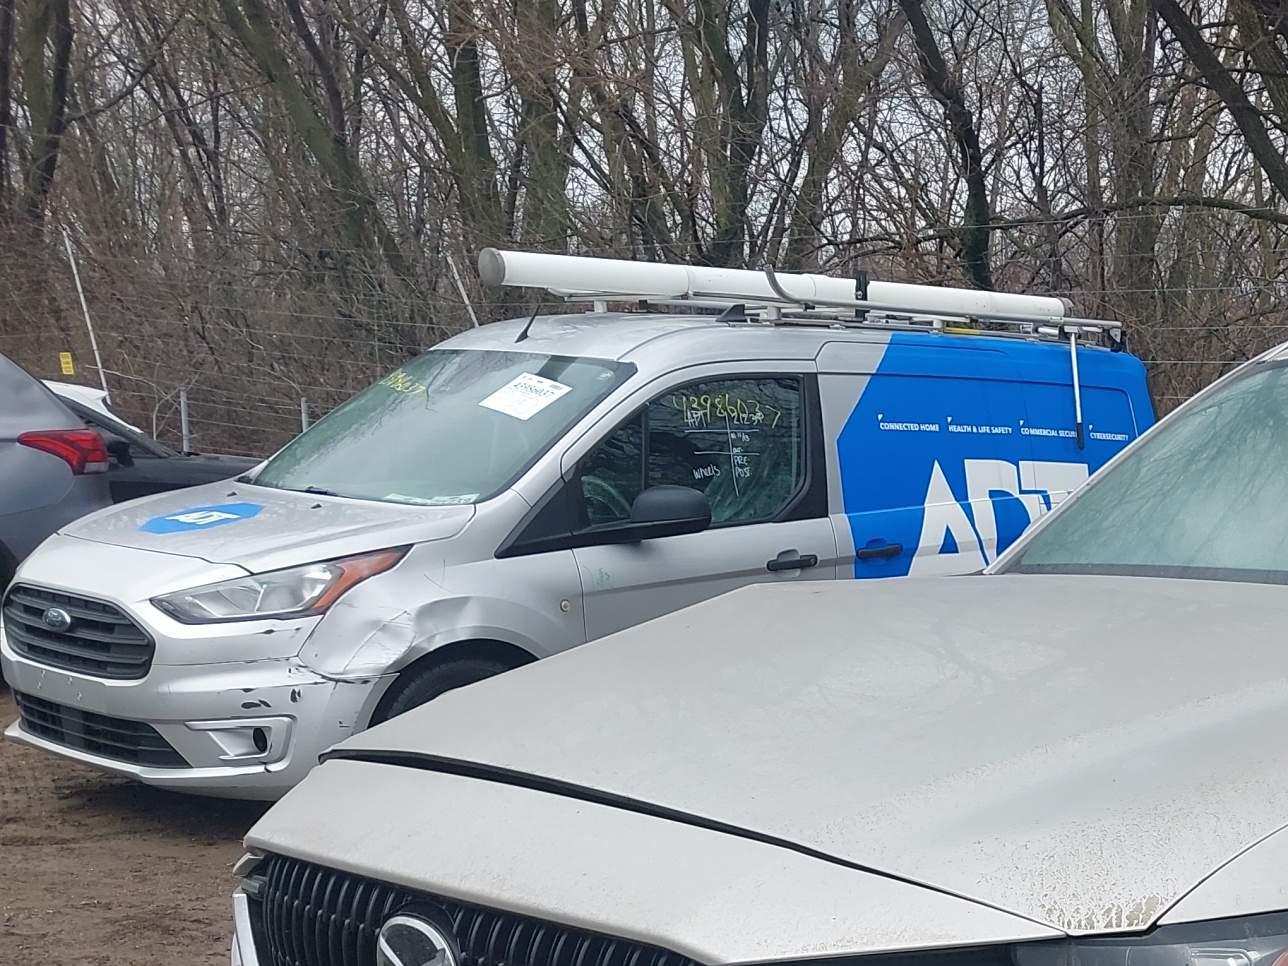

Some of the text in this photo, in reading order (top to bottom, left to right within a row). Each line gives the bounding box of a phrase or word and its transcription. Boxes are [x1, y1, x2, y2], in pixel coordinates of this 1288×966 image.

[879, 422, 940, 432] CONNECTED HOME
[948, 424, 972, 433] HEALTH
[991, 426, 1013, 434] SAFETY
[1020, 427, 1058, 436] COMMERCIAL
[1089, 432, 1129, 441] CYBERSECURITY
[907, 459, 1089, 577] ADT
